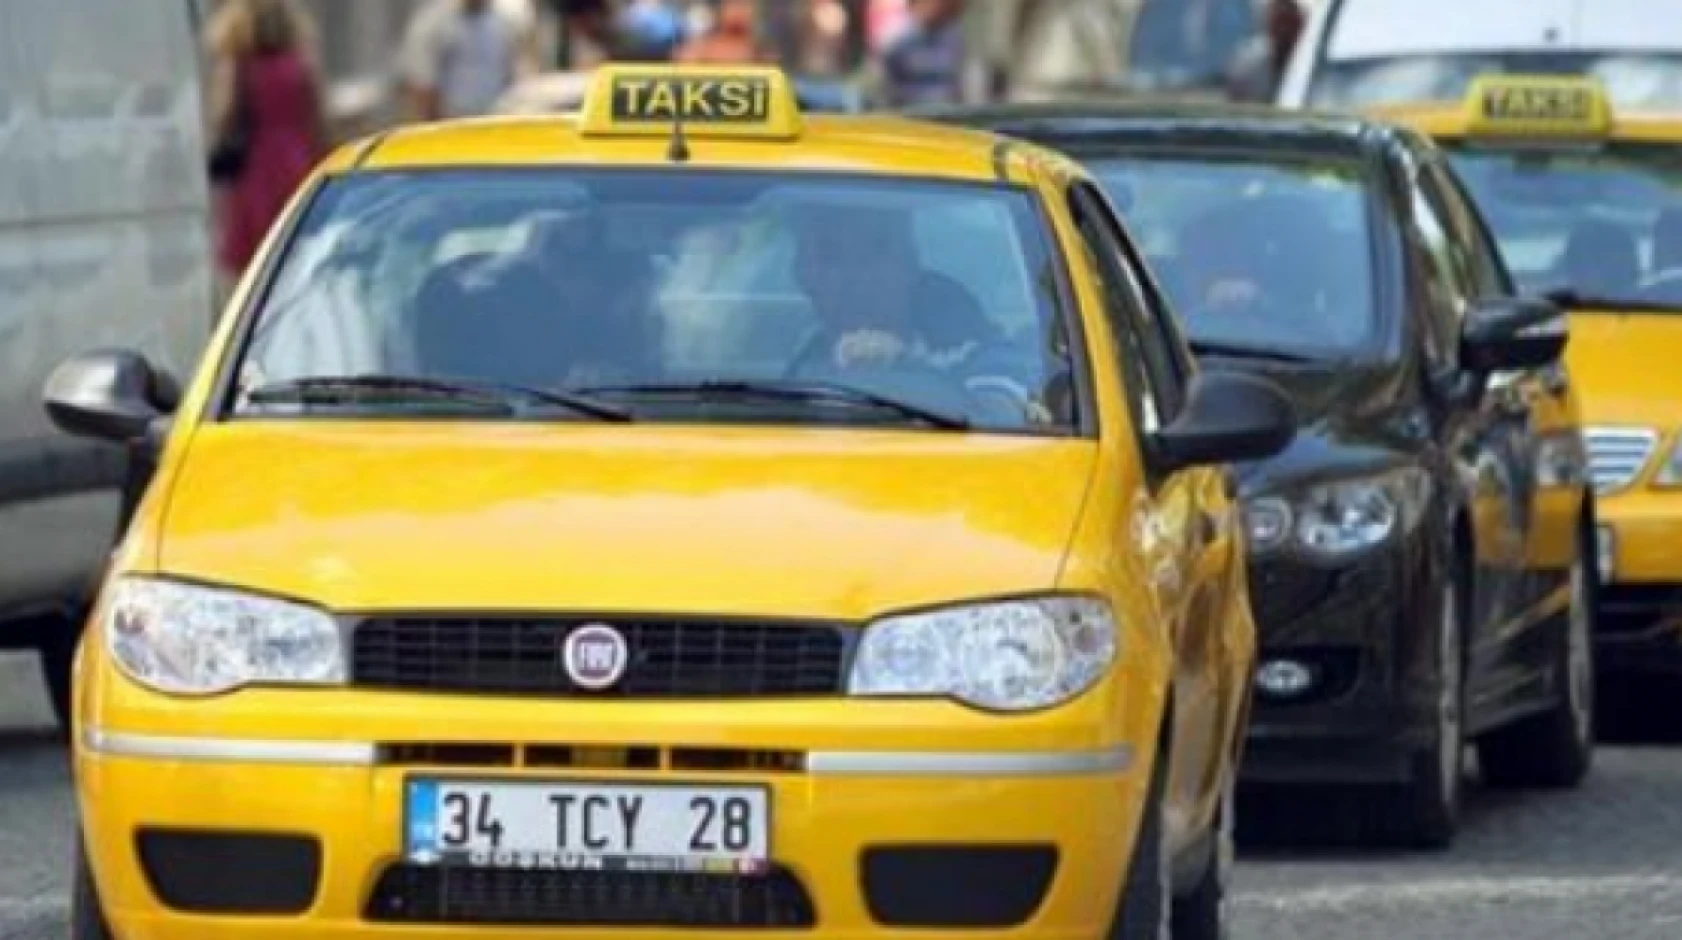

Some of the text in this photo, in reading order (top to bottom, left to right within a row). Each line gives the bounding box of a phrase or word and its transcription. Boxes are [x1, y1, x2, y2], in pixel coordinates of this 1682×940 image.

[442, 791, 752, 851] 34 TCY 28
